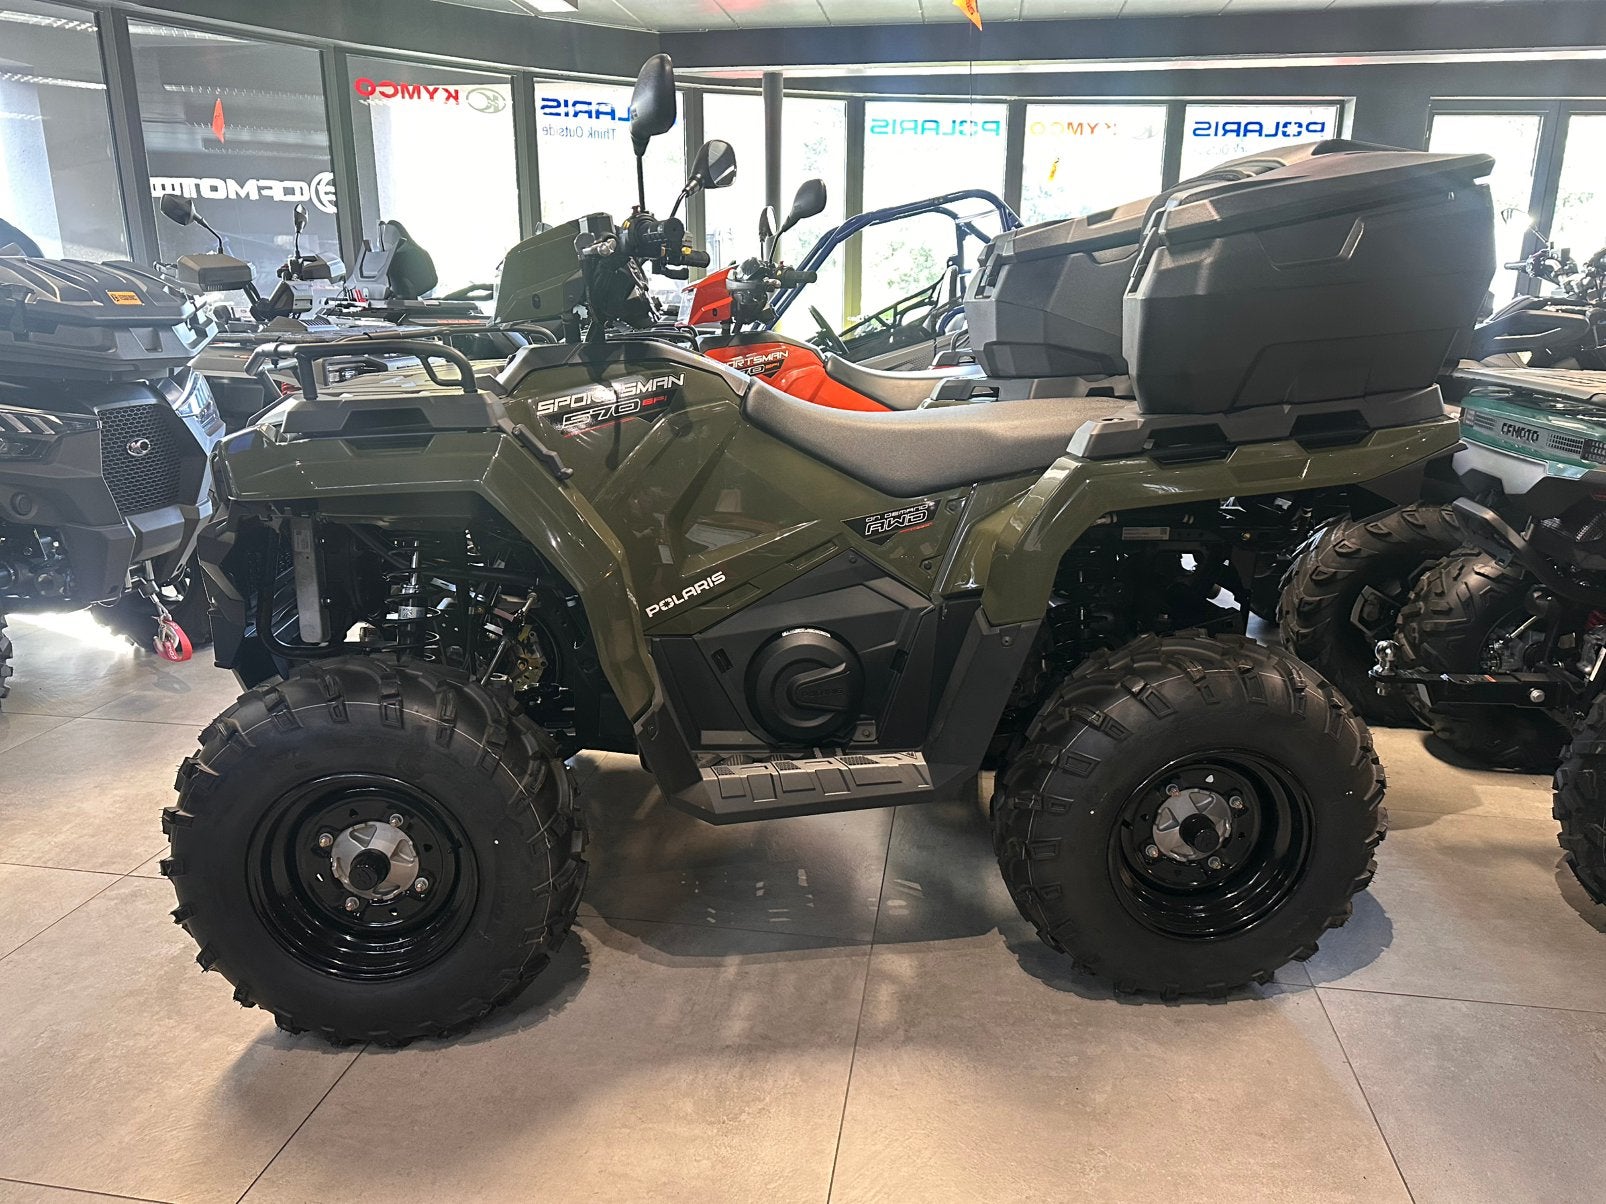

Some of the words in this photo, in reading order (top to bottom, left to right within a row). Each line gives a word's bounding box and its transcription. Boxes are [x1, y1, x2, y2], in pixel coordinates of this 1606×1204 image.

[727, 350, 789, 368] ORTSMAN
[536, 372, 686, 416] SPOSMAN
[562, 399, 641, 430] 570
[643, 395, 668, 407] EFI
[1501, 422, 1540, 443] CFMOTO
[865, 510, 928, 535] AWD
[645, 571, 726, 618] POLARIS
